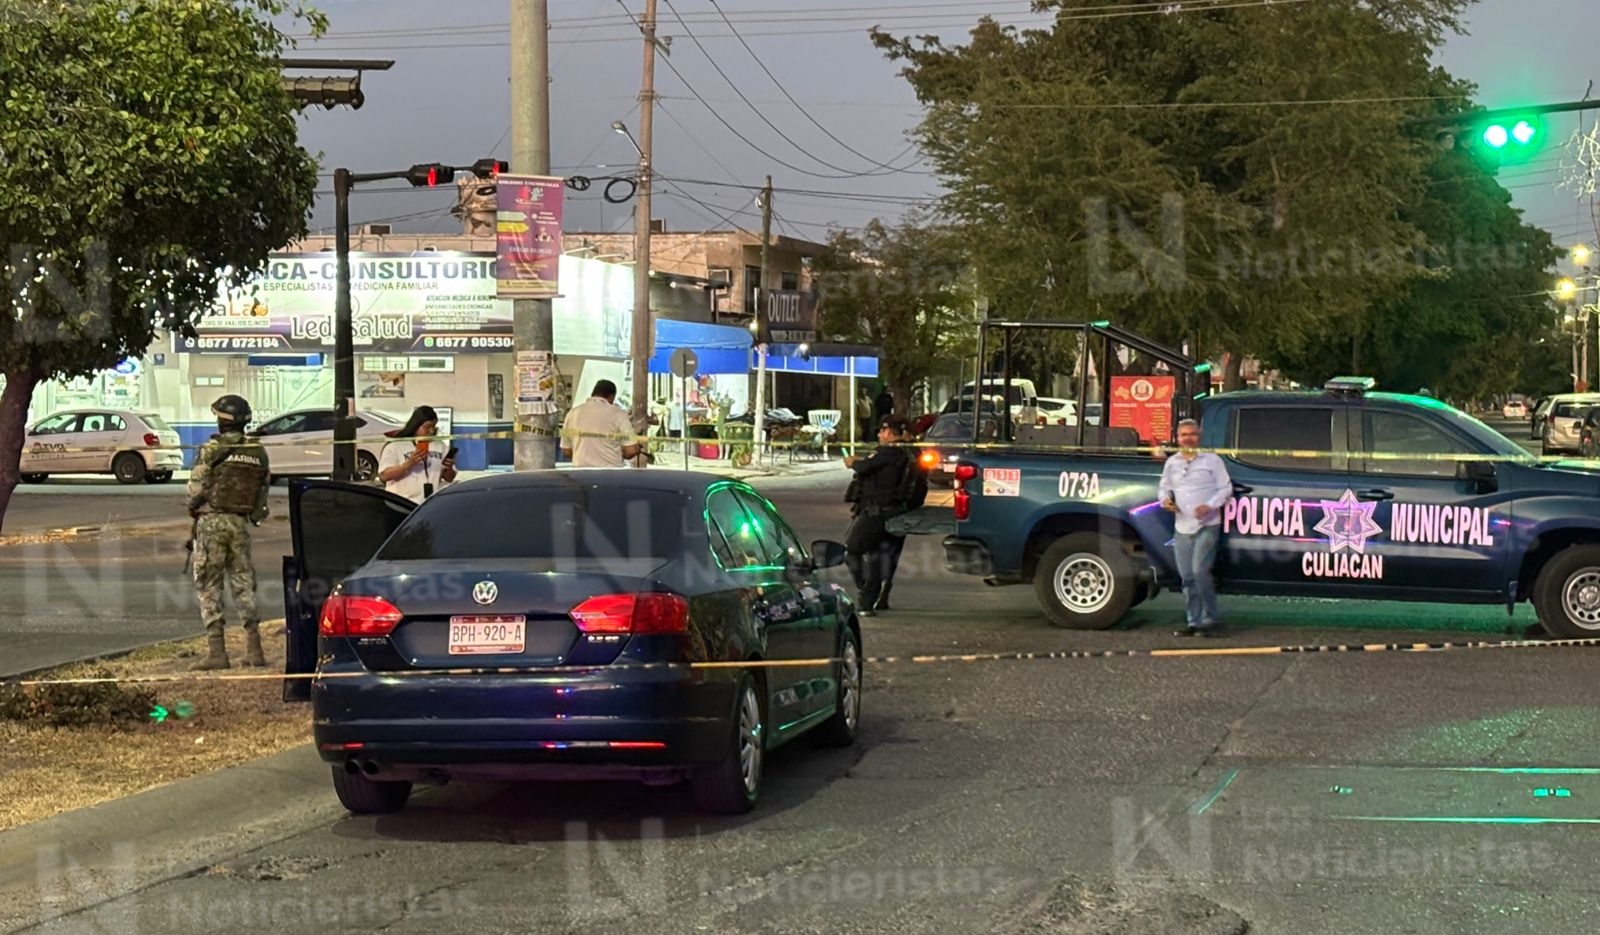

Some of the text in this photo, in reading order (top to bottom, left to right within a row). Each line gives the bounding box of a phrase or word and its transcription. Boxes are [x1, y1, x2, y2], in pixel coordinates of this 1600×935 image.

[263, 282, 333, 292] ESPECIALISTAS
[396, 281, 438, 291] FAMILIAR
[767, 292, 801, 323] OUTLET
[231, 337, 280, 348] 072194
[224, 454, 262, 466] MARINA
[1058, 471, 1100, 499] 073A
[1222, 496, 1494, 547] POLICIA MUNICIPAL
[1301, 551, 1384, 579] CULIACAN
[452, 625, 523, 643] BPH-920-A
